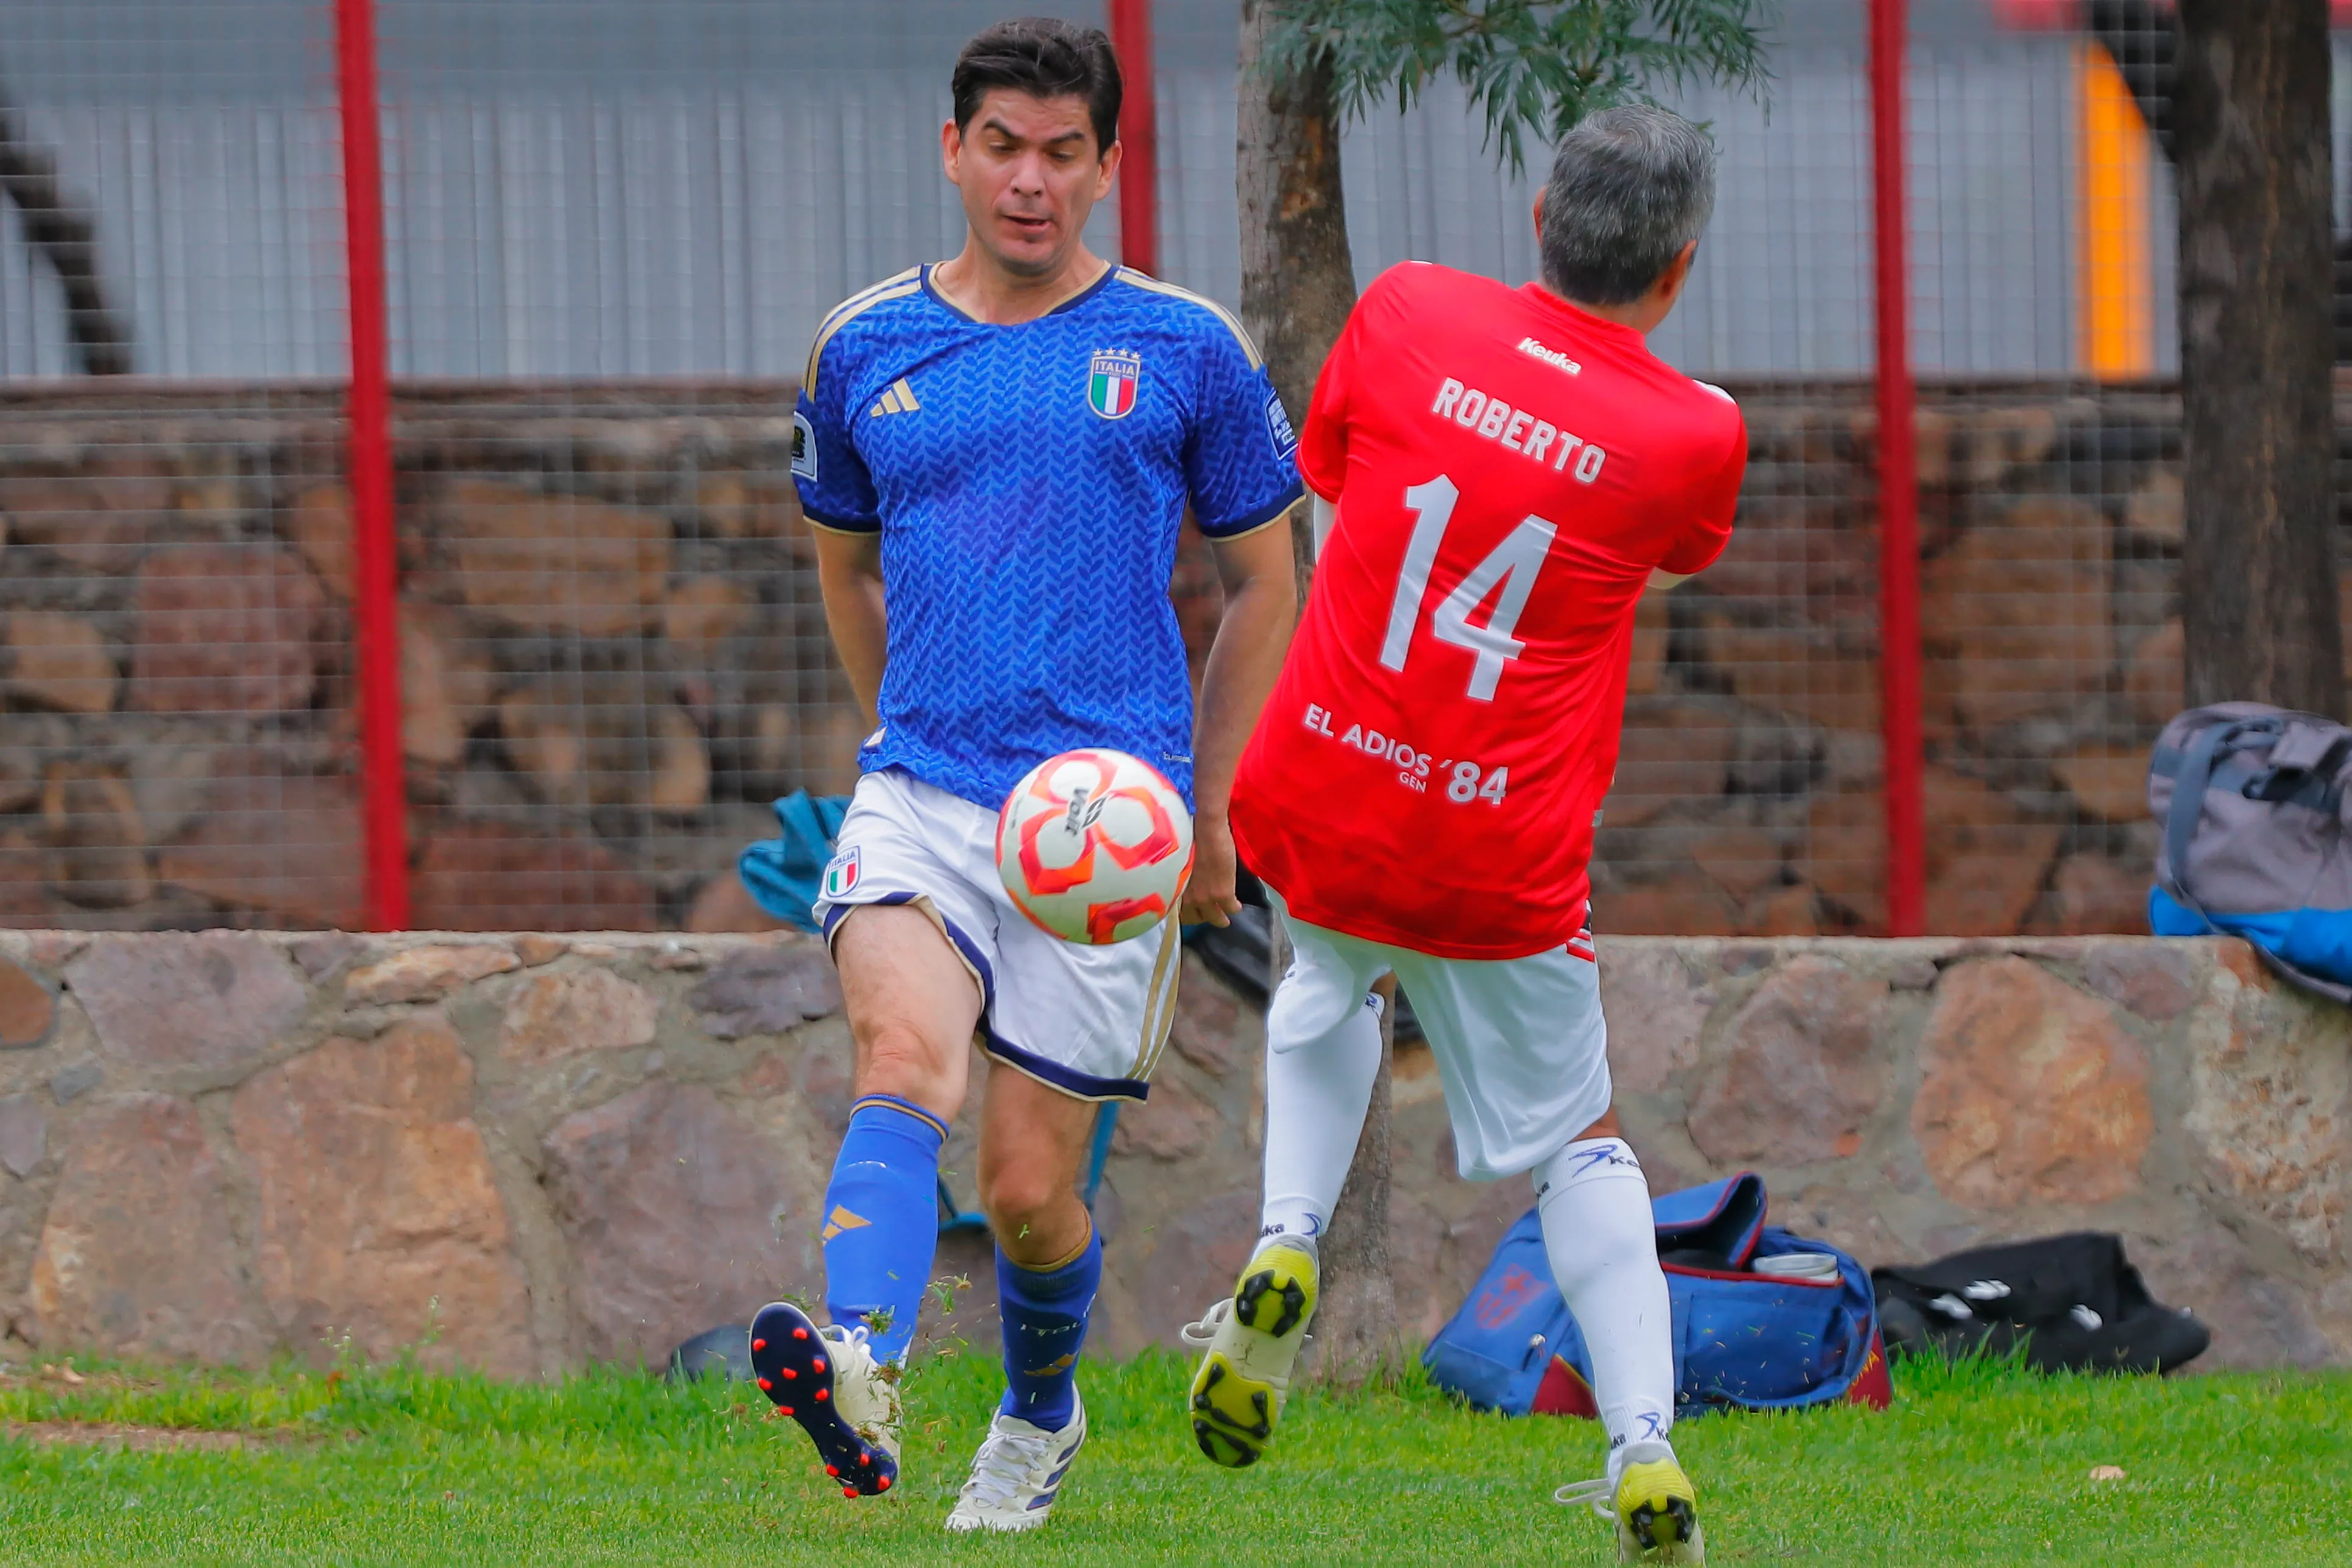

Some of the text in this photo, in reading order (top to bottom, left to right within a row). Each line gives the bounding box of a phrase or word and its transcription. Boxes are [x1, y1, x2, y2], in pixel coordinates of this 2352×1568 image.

[1095, 360, 1135, 376] ITALIA
[1517, 337, 1582, 375] Keuka
[1432, 376, 1606, 484] ROBERTO
[1380, 473, 1558, 701] 14
[1304, 703, 1334, 737] EL
[1341, 723, 1432, 776] ADIOS
[1399, 771, 1427, 793] GEN
[831, 851, 856, 868] ITALIA
